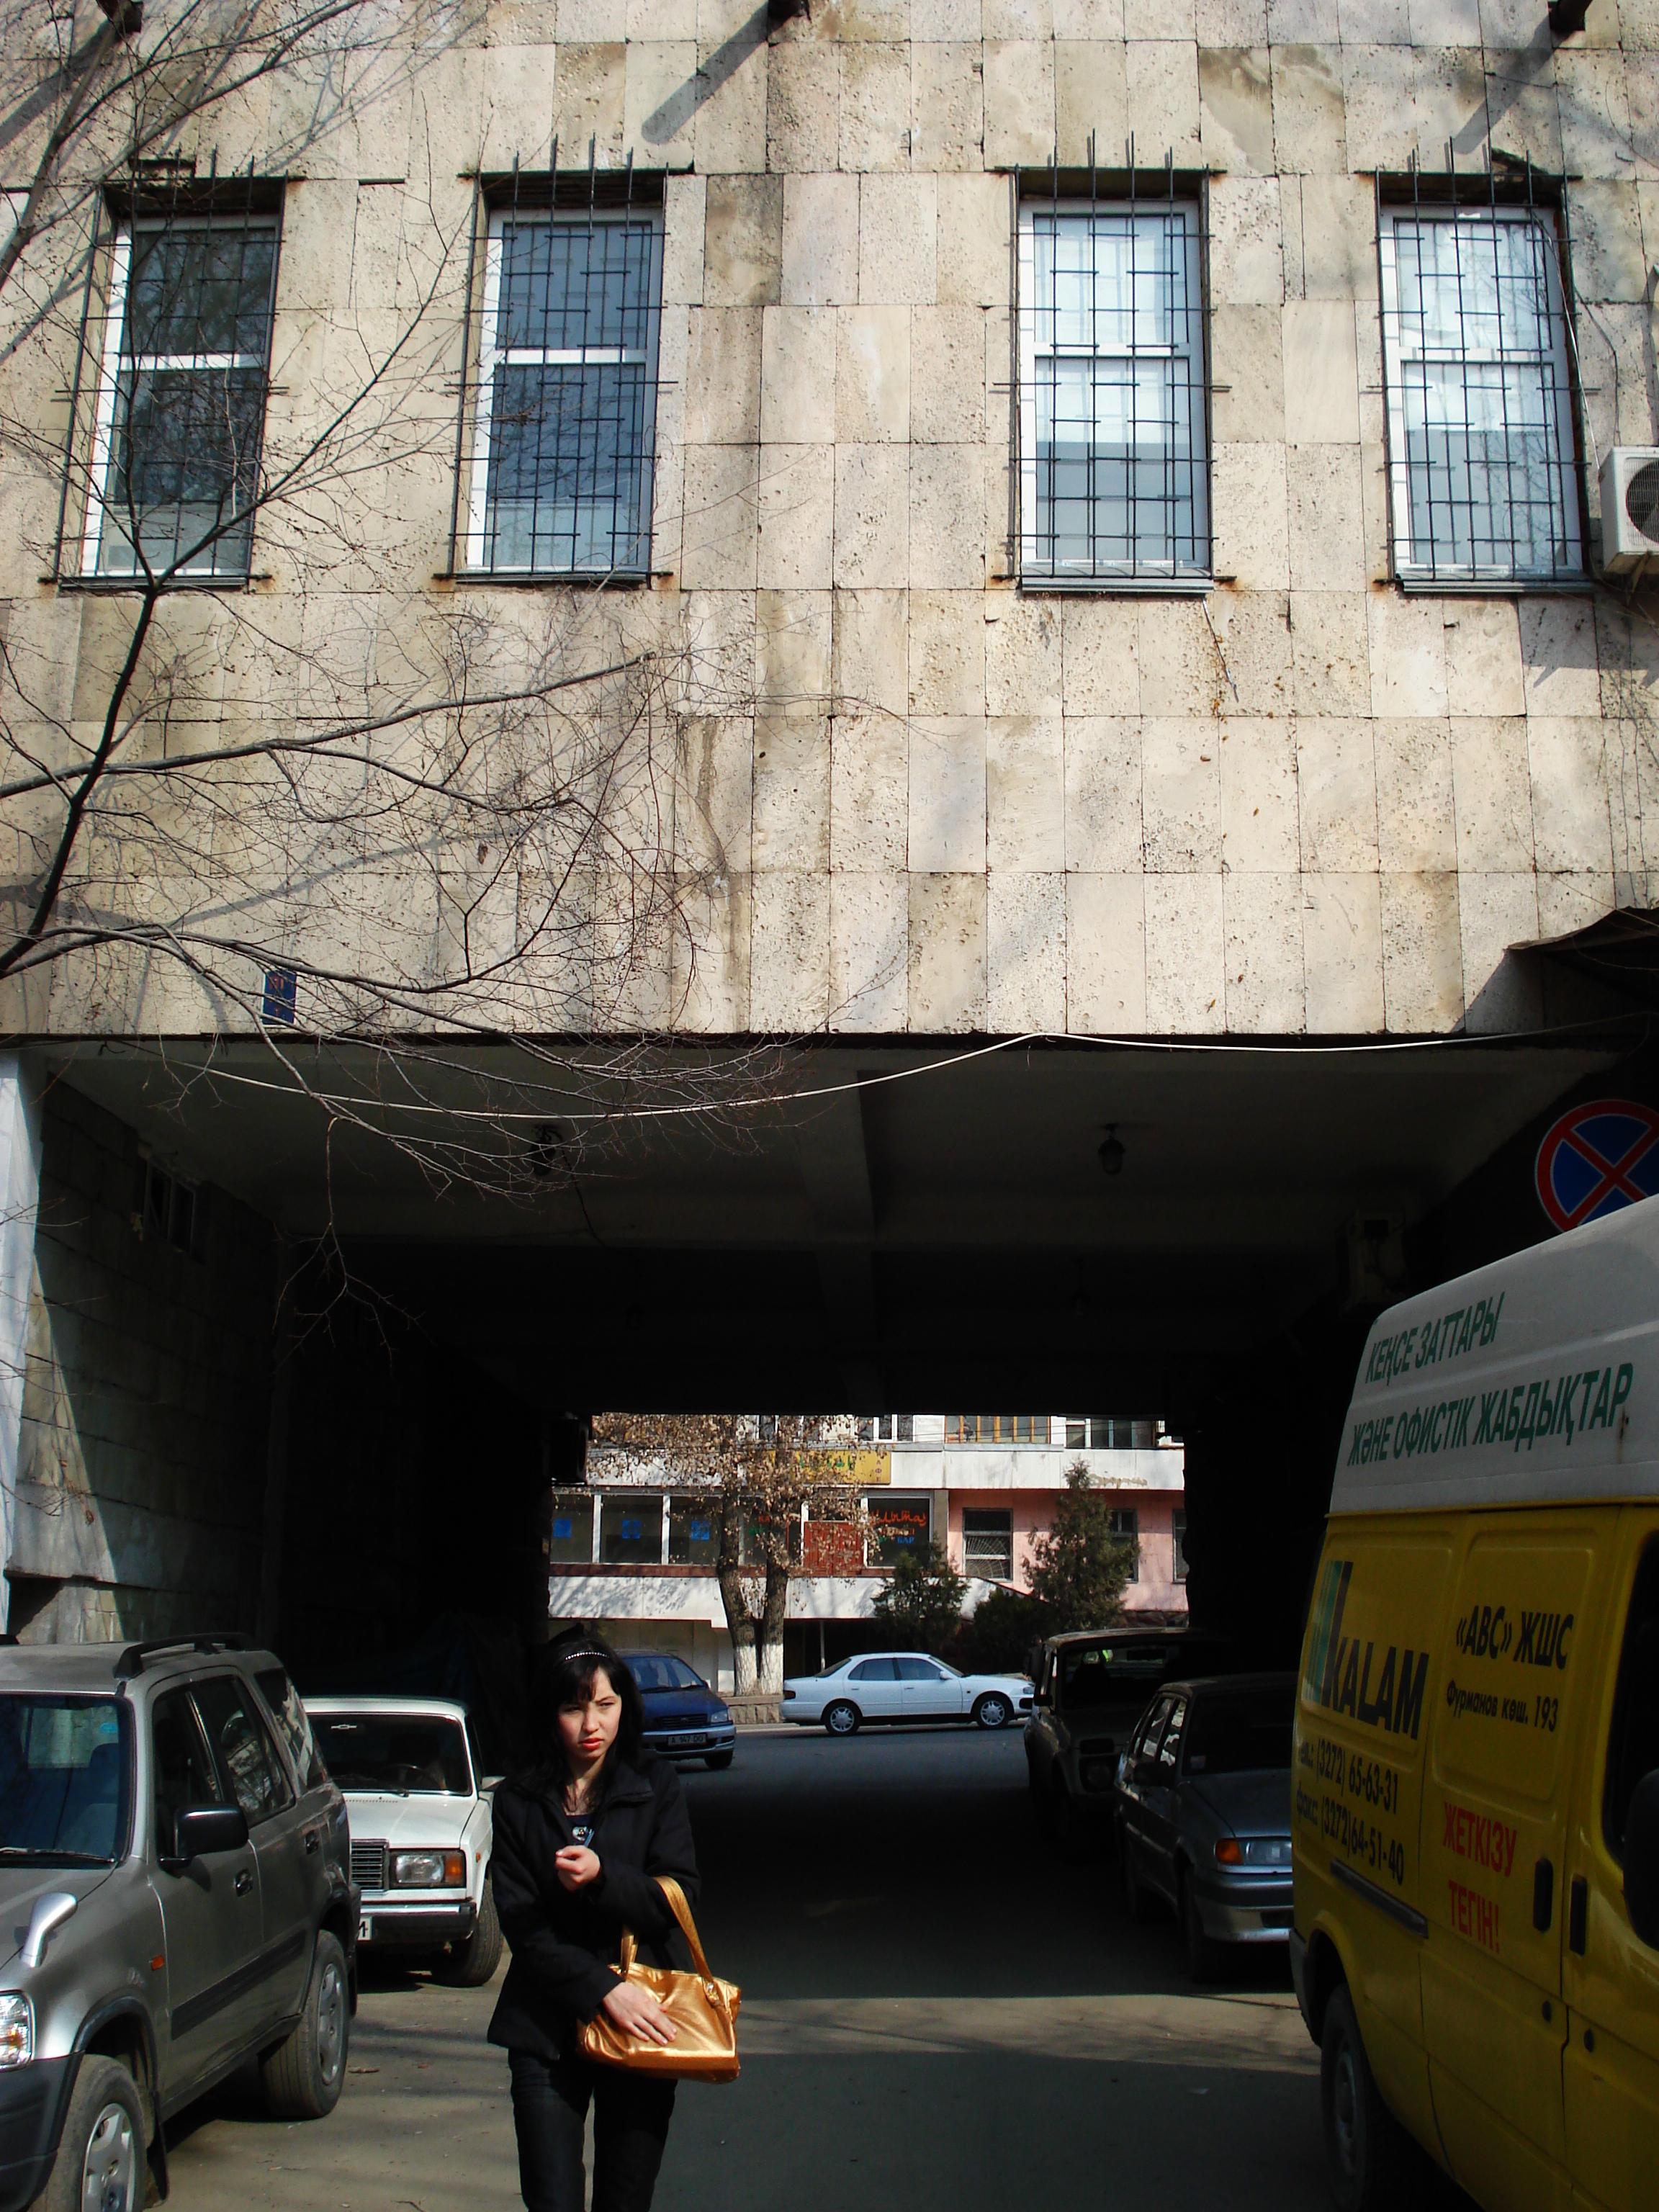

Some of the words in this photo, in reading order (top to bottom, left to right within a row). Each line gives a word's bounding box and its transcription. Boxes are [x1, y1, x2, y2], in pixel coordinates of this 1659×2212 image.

[1415, 1292, 1506, 1369] ЗАТТАРЫ
[1346, 1415, 1395, 1467] ЖӘНЕ
[1472, 1362, 1634, 1453] ЖАБДЫҚТАР
[1321, 1561, 1429, 1740] KALAM
[1513, 1611, 1574, 1670] ЖШС
[1447, 1679, 1498, 1718] Фурманов
[1534, 1696, 1558, 1732] 193
[1316, 1738, 1346, 1797] (3272)
[1349, 1755, 1398, 1815] 65-63-31
[1442, 1802, 1518, 1878] ЖЕТКІЗУ
[1449, 1879, 1500, 1954] ТЕГІН!
